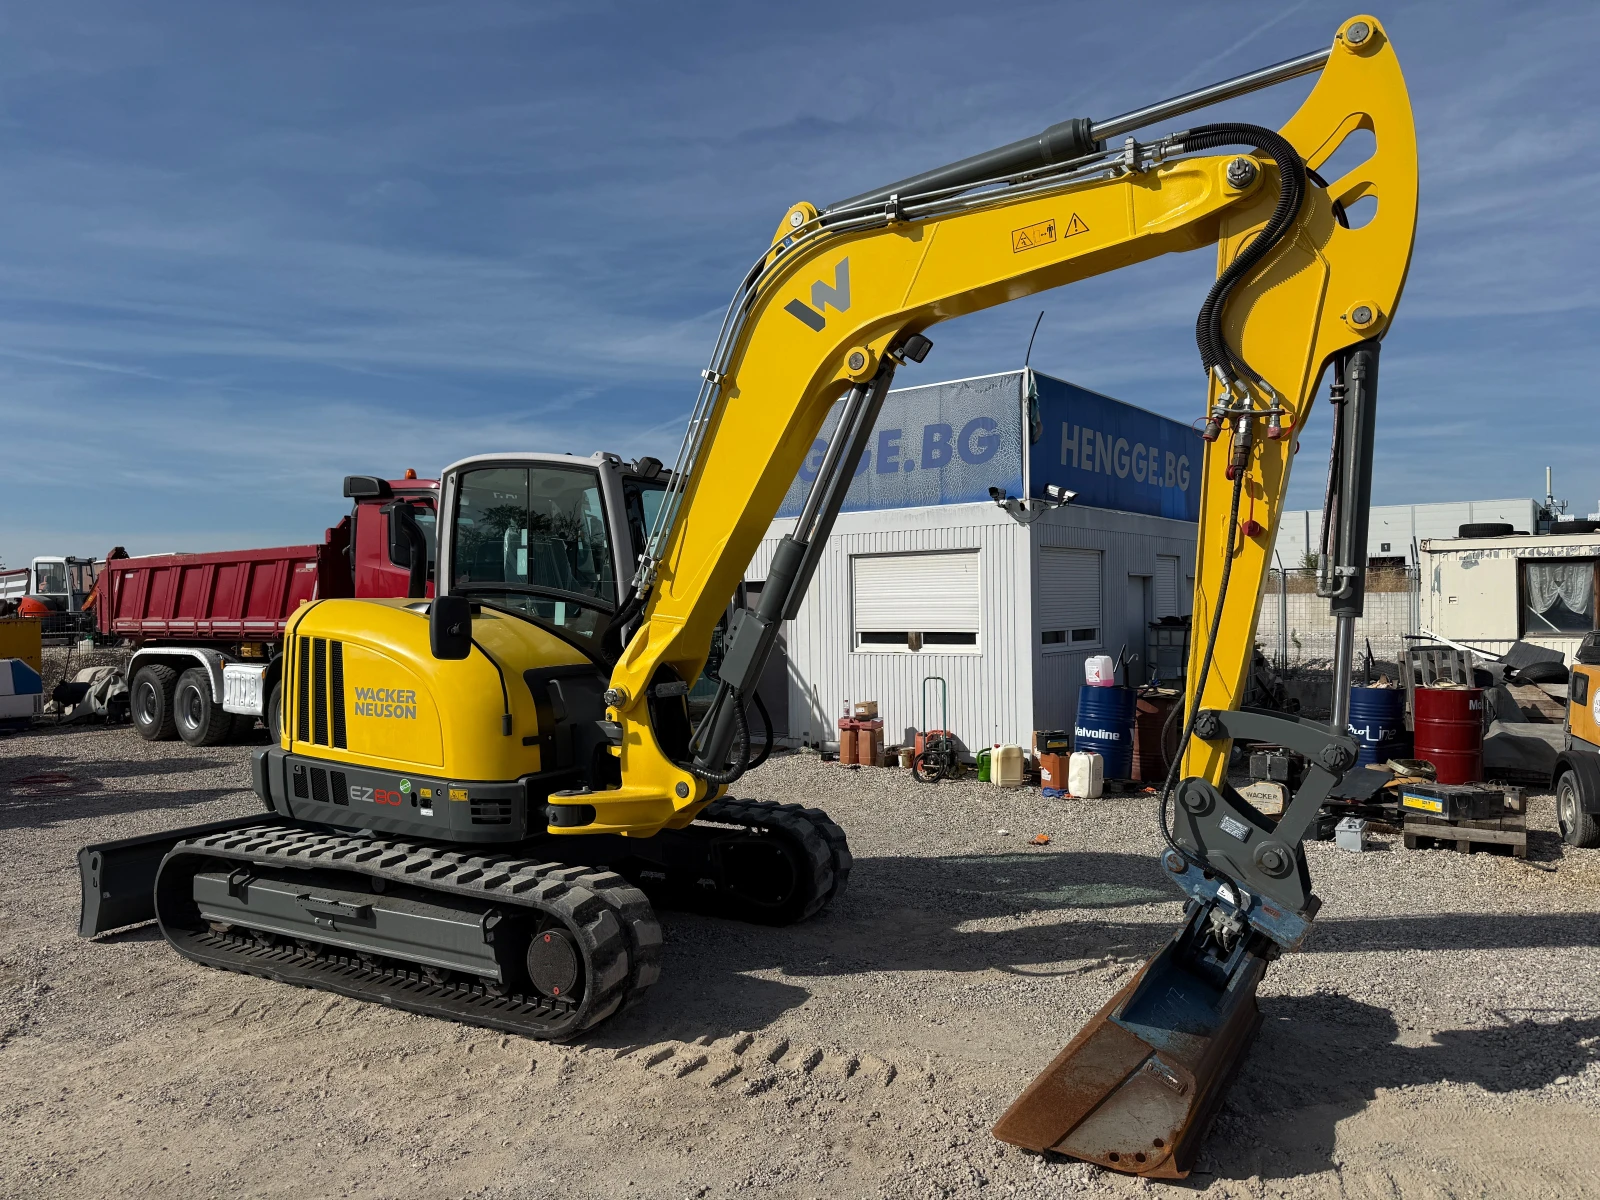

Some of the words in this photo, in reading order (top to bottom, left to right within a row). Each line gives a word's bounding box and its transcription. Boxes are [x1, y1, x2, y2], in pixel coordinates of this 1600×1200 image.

[1060, 422, 1190, 492] HENGGE.BG
[354, 686, 417, 704] WACKER
[354, 703, 417, 719] NEUSON
[1074, 725, 1121, 741] Valvoline
[350, 784, 402, 807] EZ80
[1245, 791, 1278, 800] WACKER
